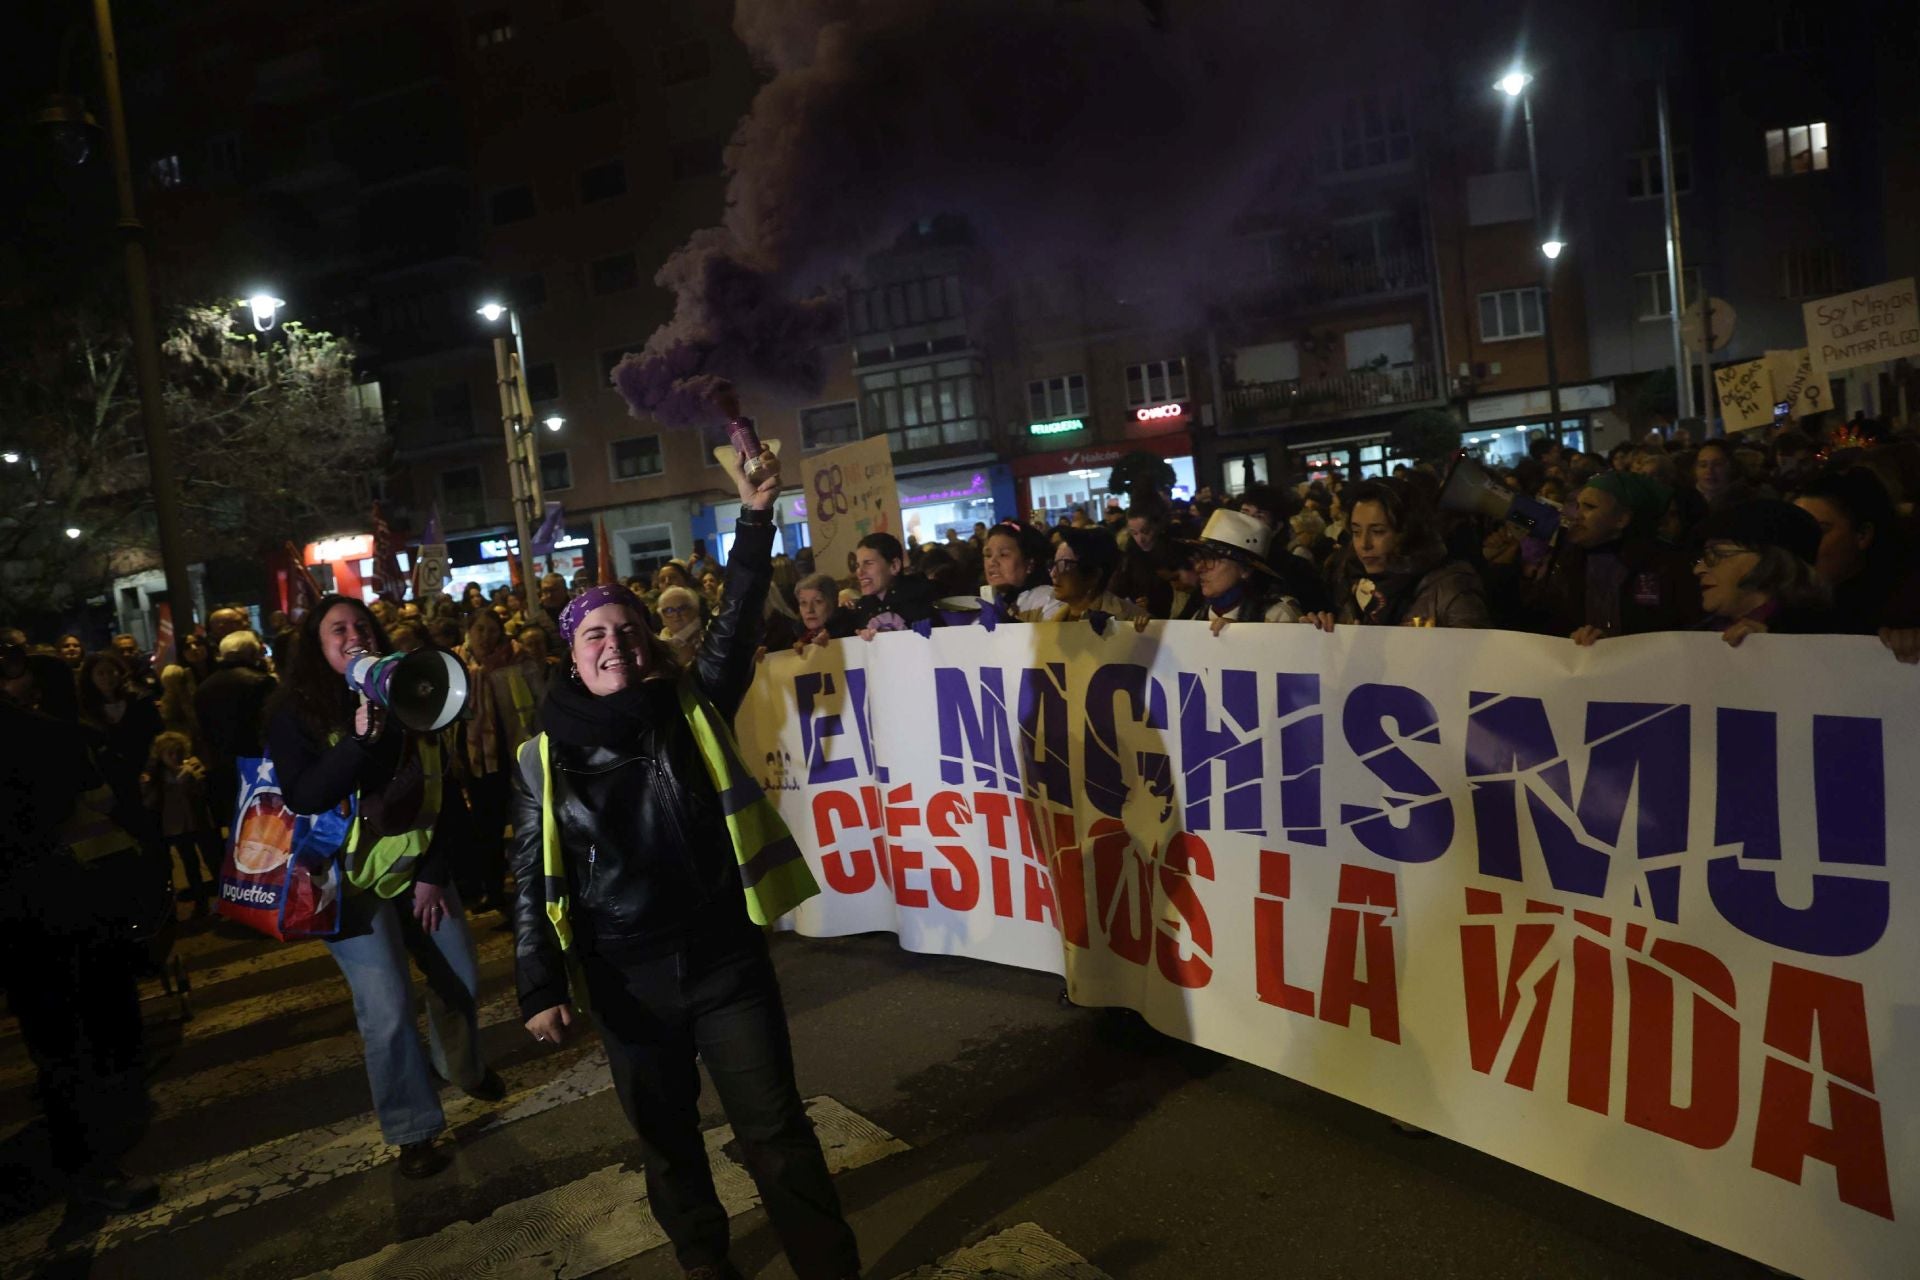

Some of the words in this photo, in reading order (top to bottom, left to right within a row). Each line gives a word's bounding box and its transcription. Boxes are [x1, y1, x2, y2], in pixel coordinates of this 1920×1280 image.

[795, 667, 890, 785] EL
[934, 662, 1890, 956] MACHISMU
[1254, 849, 1401, 1045] LA
[1459, 886, 1895, 1221] VIDA
